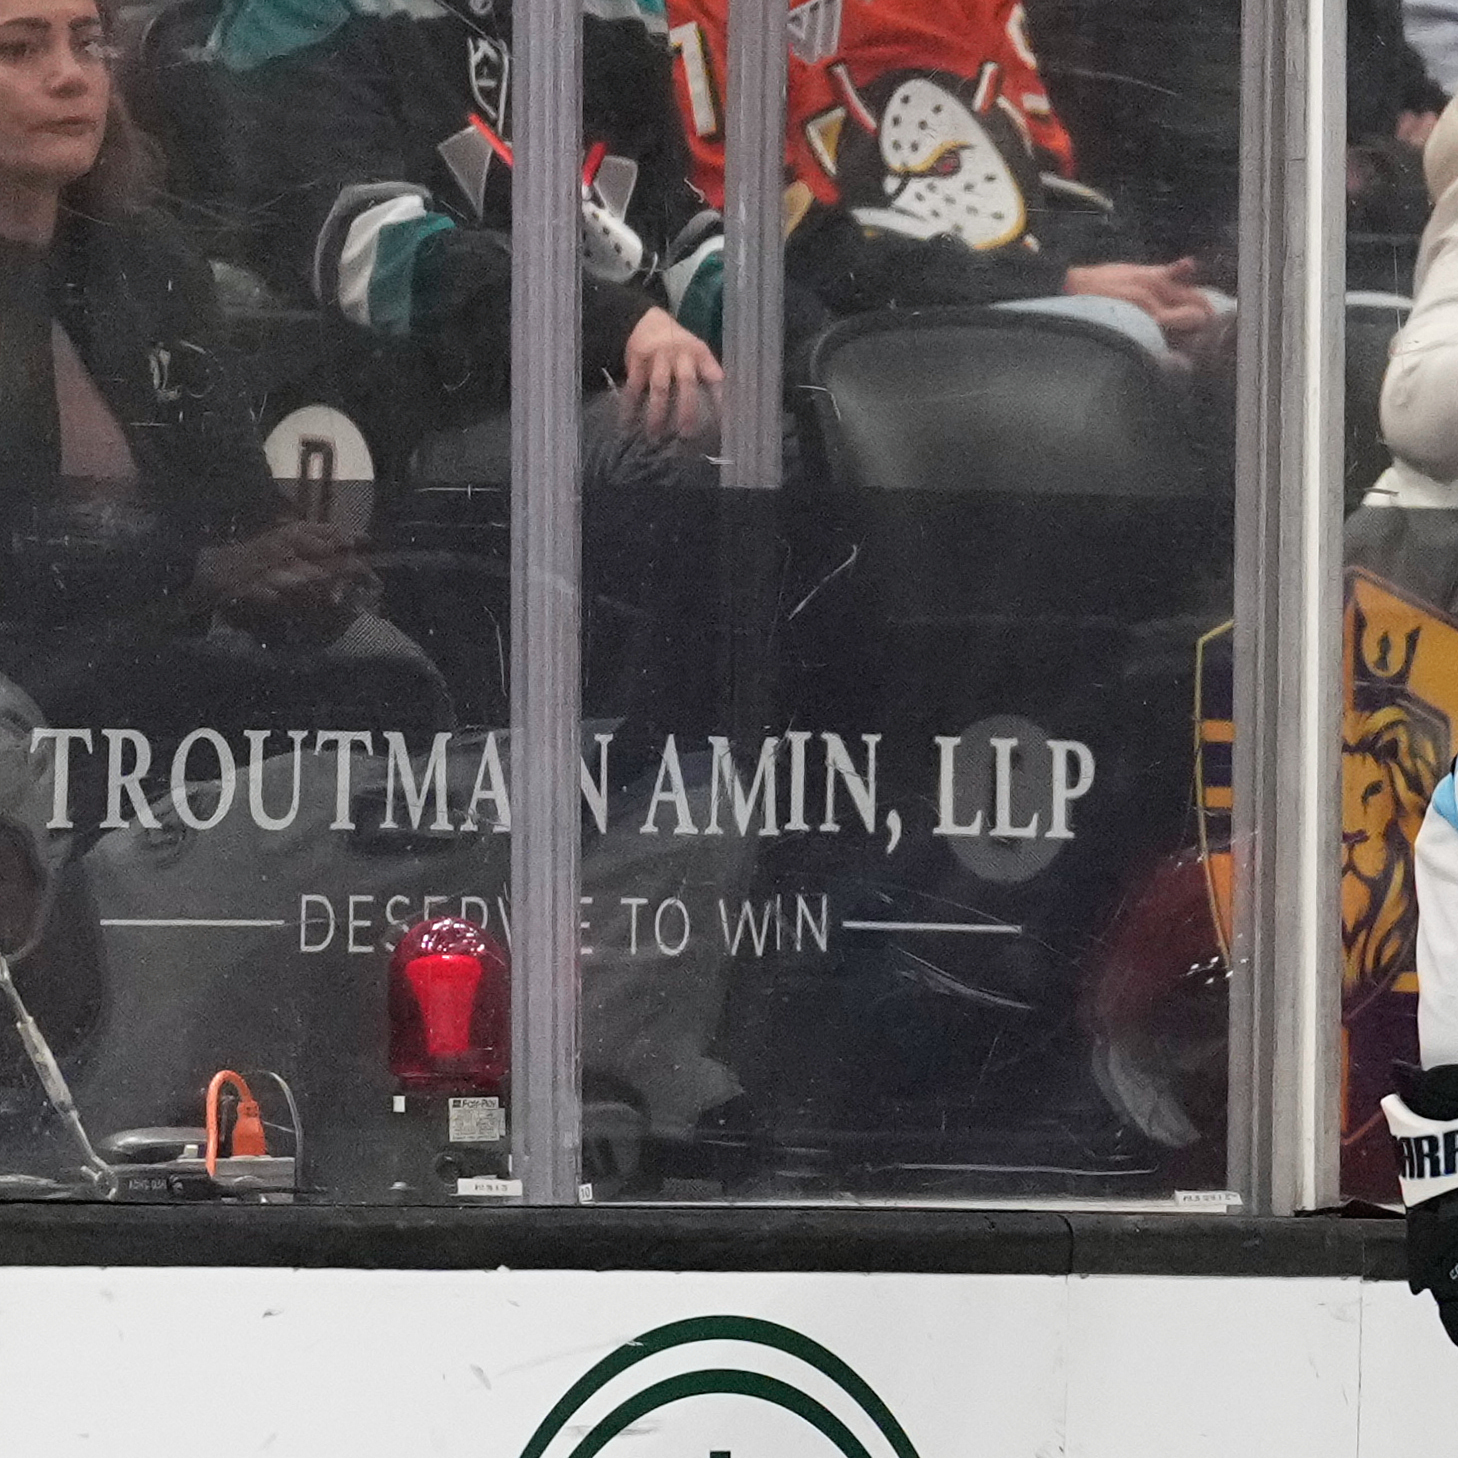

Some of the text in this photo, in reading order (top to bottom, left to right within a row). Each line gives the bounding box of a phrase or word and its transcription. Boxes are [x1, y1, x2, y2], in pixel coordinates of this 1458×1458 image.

[30, 727, 1096, 854] TROUTMAN AMIN, LLP
[620, 897, 691, 956] TO
[718, 895, 828, 957] WIN
